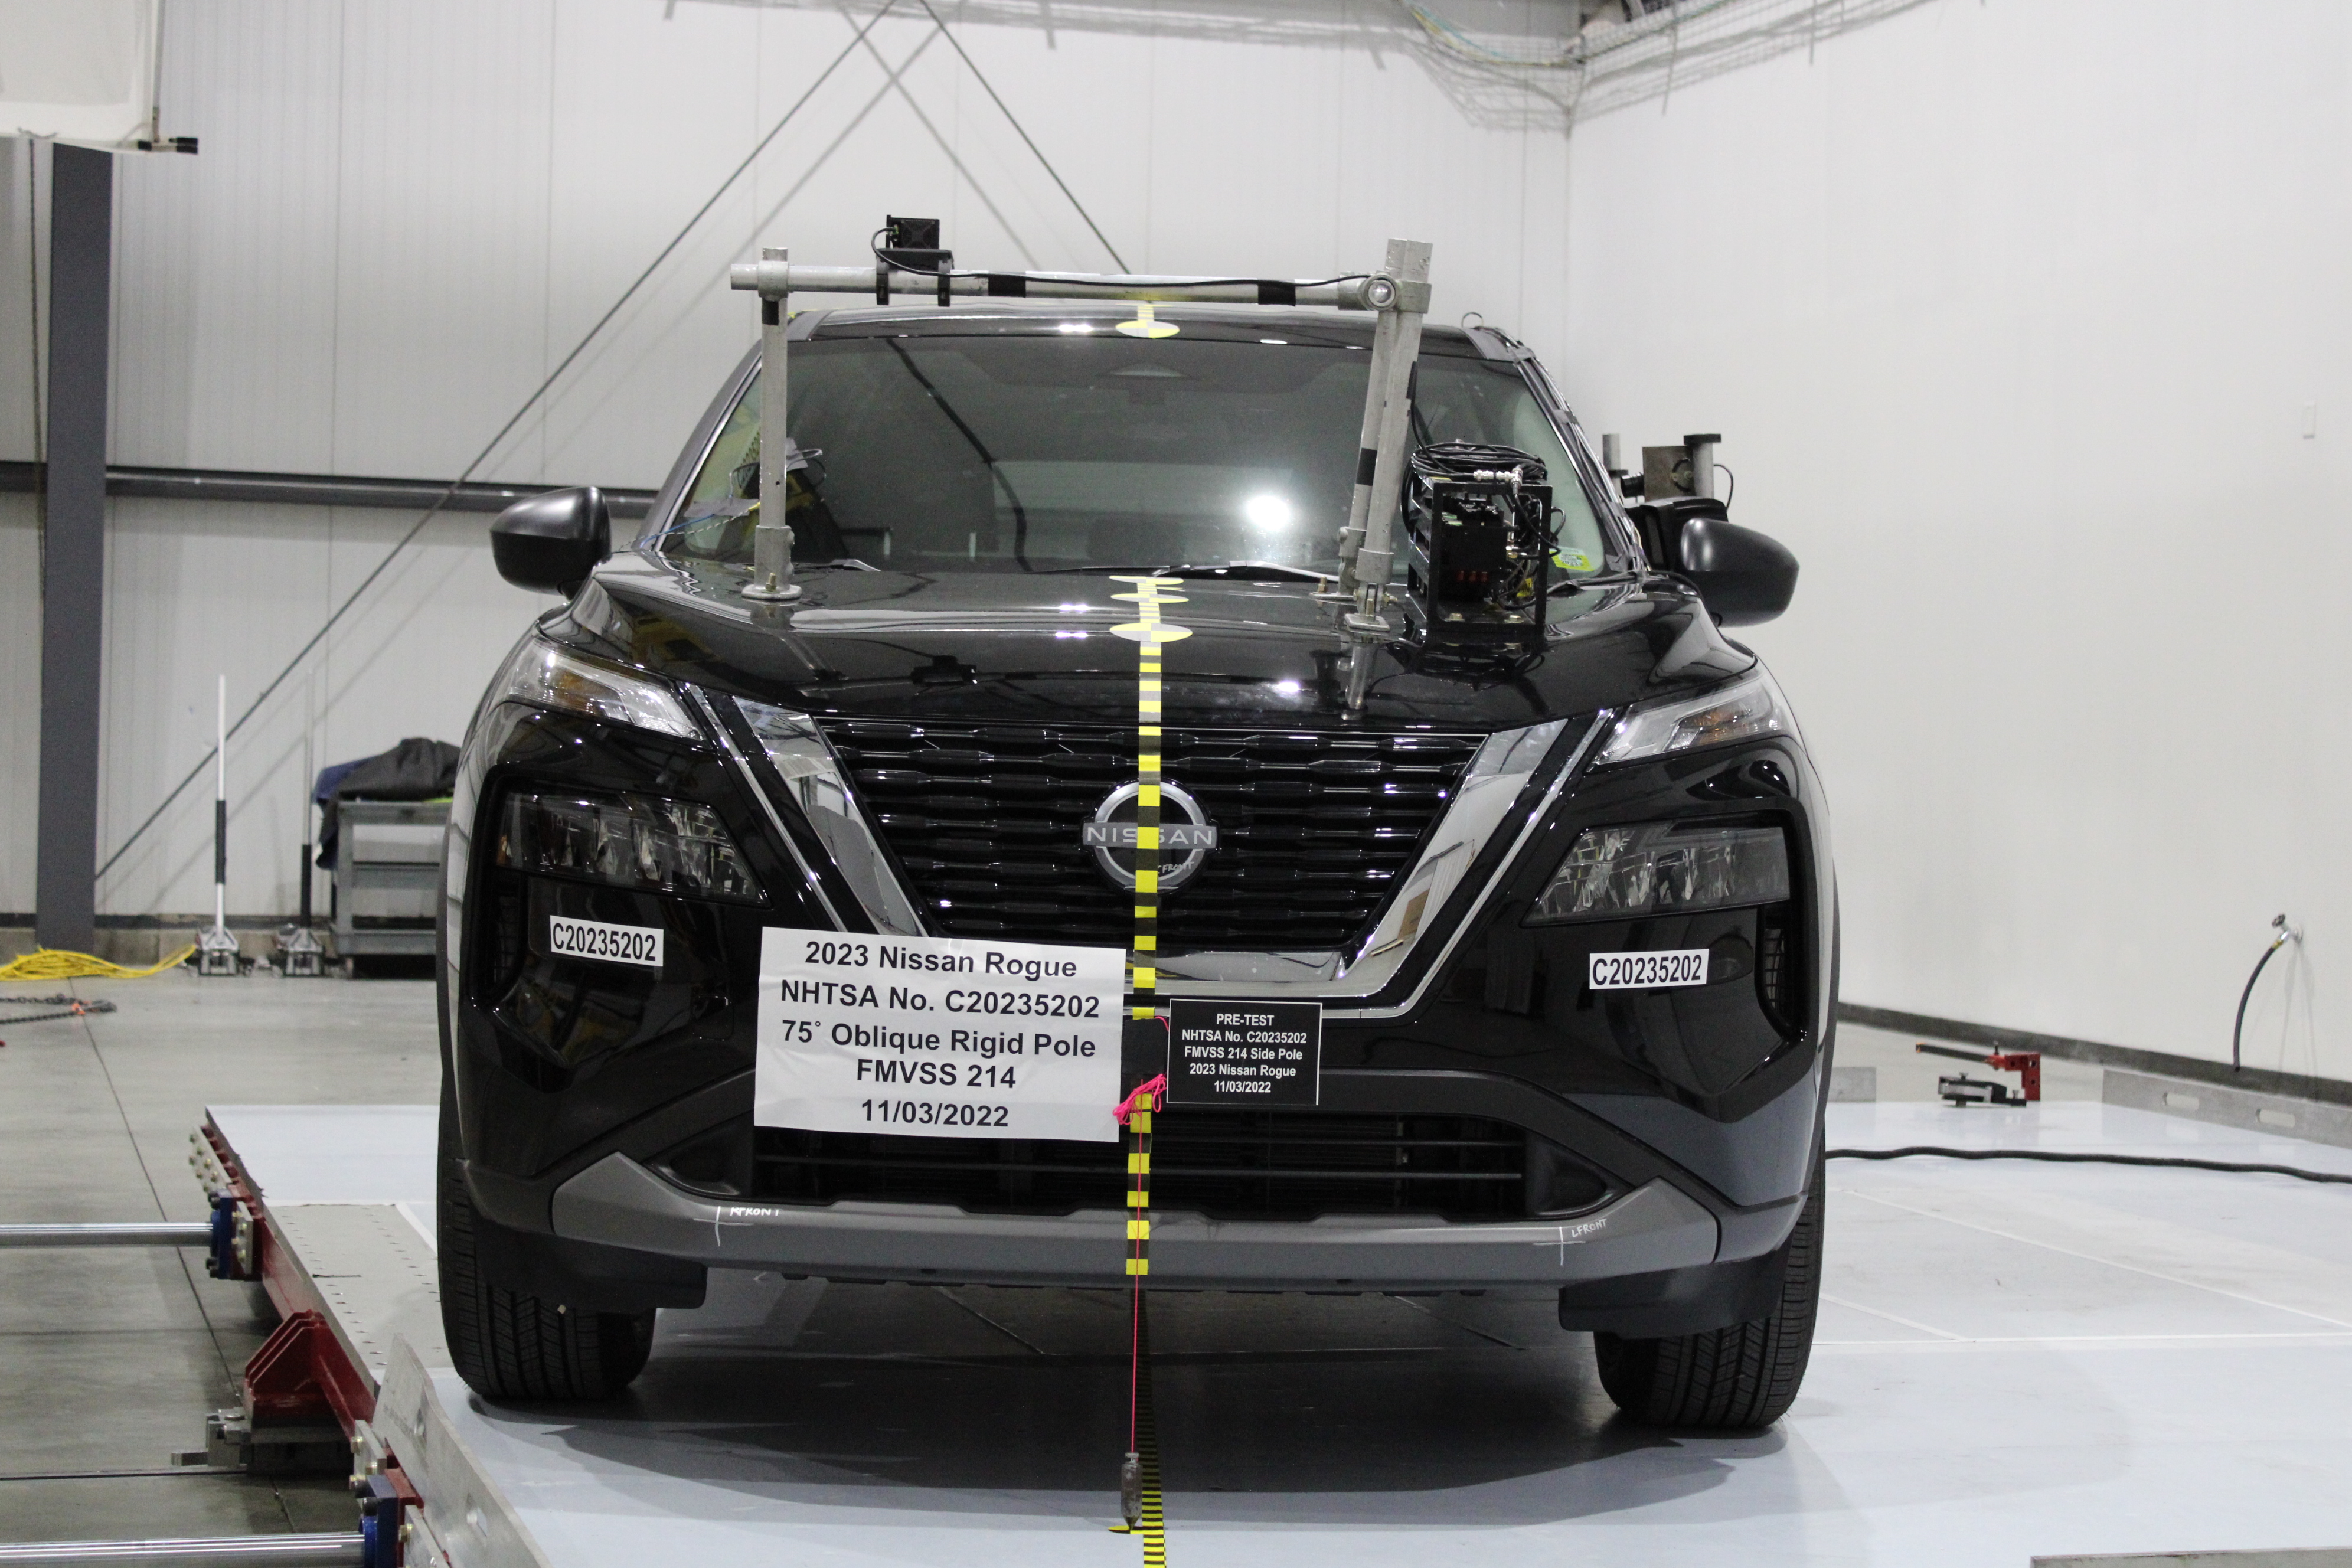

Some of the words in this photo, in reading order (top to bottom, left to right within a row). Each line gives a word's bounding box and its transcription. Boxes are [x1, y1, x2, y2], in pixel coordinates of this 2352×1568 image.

[553, 923, 656, 961] C20235202
[805, 941, 868, 966] 2023
[879, 946, 974, 973] Nissan
[985, 952, 1077, 981] Rogue
[1593, 954, 1702, 986] C20235202
[782, 979, 879, 1008] NHTSA
[889, 986, 934, 1011] No.
[945, 990, 1099, 1018] C20235202
[1216, 1013, 1275, 1026] PRE-TEST
[782, 1020, 821, 1043] 75°
[831, 1023, 940, 1054] Oblique
[951, 1030, 1023, 1059] Rigid
[1034, 1034, 1096, 1057] Pole
[1182, 1029, 1223, 1041] NHTSA
[1225, 1031, 1243, 1043] No.
[1246, 1031, 1307, 1044] C20235202
[1184, 1046, 1225, 1059] FMVSS
[1227, 1047, 1247, 1059] 214
[1250, 1048, 1275, 1060] Side
[1278, 1048, 1303, 1060] Pole
[857, 1059, 957, 1086] FMVSS
[966, 1064, 1016, 1089] 214
[1189, 1063, 1216, 1075] 2023
[1219, 1064, 1257, 1076] Nissan
[1260, 1064, 1296, 1079] Rogue
[1214, 1080, 1272, 1093] 11/03/2022
[862, 1099, 1008, 1127] 11/03/2022
[1571, 1218, 1608, 1238] LFRONT
